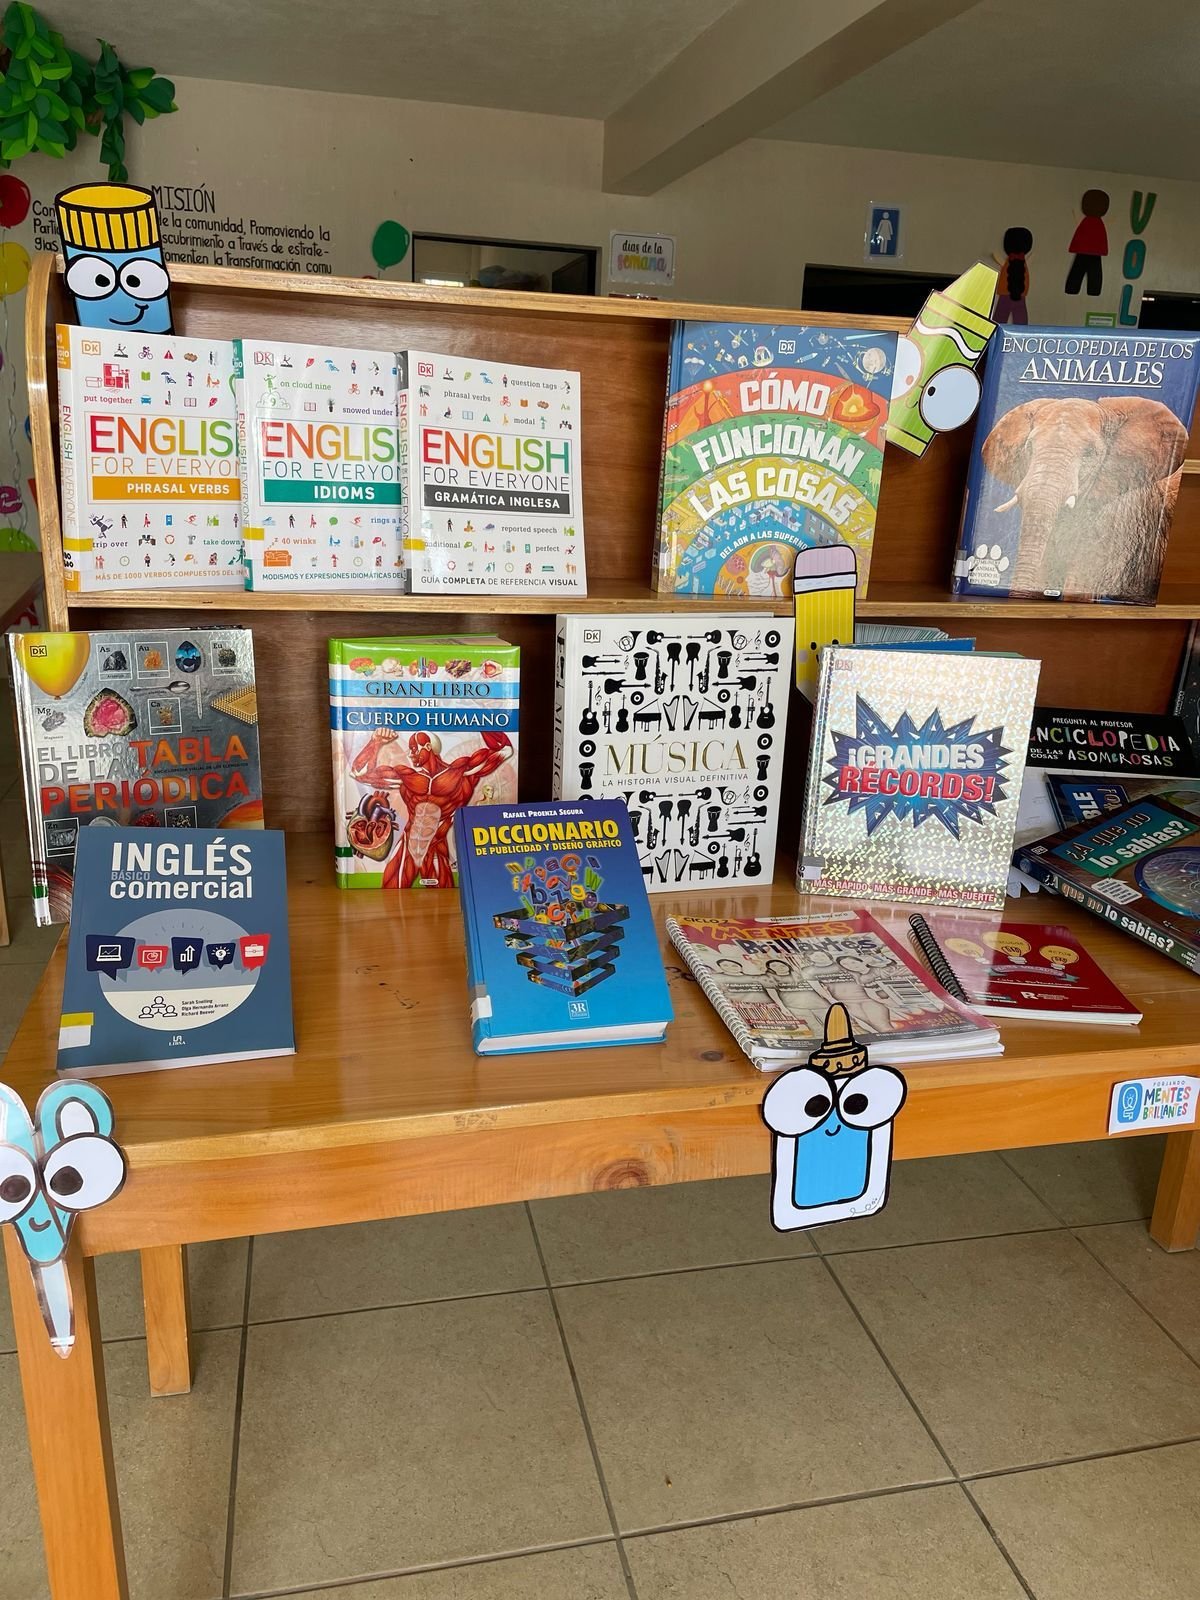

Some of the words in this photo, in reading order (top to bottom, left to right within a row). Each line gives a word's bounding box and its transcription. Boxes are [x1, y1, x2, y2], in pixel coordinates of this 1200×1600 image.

[151, 183, 215, 214] MISIÓN
[172, 212, 182, 228] la
[185, 217, 247, 236] comunidad,
[250, 220, 315, 239] Promoviendo
[319, 225, 331, 241] la
[162, 231, 224, 250] scubrimiento
[228, 239, 236, 249] a
[271, 239, 284, 254] de
[642, 240, 652, 254] de
[654, 242, 663, 255] la
[213, 251, 223, 266] la
[84, 342, 99, 354] DK
[780, 342, 794, 353] DK
[1001, 336, 1130, 358] ENCICLOPEDIA
[1132, 341, 1157, 359] DE
[1160, 342, 1195, 360] LOS
[255, 352, 273, 363] DK
[419, 363, 432, 375] DK
[1020, 357, 1165, 385] ANIMALES
[292, 380, 312, 389] cloud
[314, 382, 332, 391] nine
[510, 377, 540, 390] question
[541, 380, 558, 391] tags
[84, 394, 98, 404] put
[99, 395, 133, 405] together
[443, 389, 471, 401] phrasal
[472, 392, 491, 403] verbs
[738, 372, 831, 416] CÓMO
[342, 405, 370, 416] snowed
[371, 407, 394, 417] under
[513, 416, 536, 426] modal
[62, 405, 73, 460] ENGLISH
[90, 414, 239, 457] ENGLIS
[239, 412, 247, 465] ENGLISH
[261, 422, 400, 463] ENGLIS
[422, 428, 570, 474] ENGLISH
[691, 424, 865, 478] FUNCIONAN
[91, 456, 134, 475] FOR
[262, 460, 302, 479] FOR
[423, 466, 459, 485] FOR
[468, 470, 570, 493] EVERYONE
[126, 483, 186, 495] PHRASAL
[189, 483, 230, 495] VERBS
[313, 485, 375, 500] IDIOMS
[689, 470, 751, 522] LAS
[756, 467, 859, 525] COSAS
[434, 491, 506, 506] GRAMÁTICA
[509, 496, 560, 509] INGLESA
[501, 524, 533, 534] reported
[533, 525, 558, 535] speech
[112, 540, 128, 548] over
[203, 538, 222, 546] take
[223, 538, 241, 546] down
[293, 537, 316, 545] winks
[535, 543, 560, 553] perfect
[719, 545, 734, 560] DEL
[732, 535, 749, 549] ADN
[750, 532, 756, 541] A
[757, 530, 773, 539] LAS
[144, 571, 173, 579] VERBOS
[174, 570, 221, 578] COMPUESTOS
[222, 569, 234, 577] DEL
[262, 573, 299, 581] MODISMOS
[305, 572, 350, 580] EXPRESIONES
[350, 571, 392, 580] IDIOMÁTICAS
[420, 573, 441, 585] GUÍA
[442, 576, 486, 586] COMPLETA
[488, 576, 499, 586] DE
[500, 577, 547, 587] REFERENCIA
[549, 577, 578, 587] VISUAL
[585, 631, 600, 642] DK
[31, 647, 46, 656] DK
[99, 645, 111, 653] As
[365, 680, 423, 697] GRAN
[431, 681, 491, 697] LIBRO
[419, 698, 439, 707] DEL
[36, 707, 52, 717] Mg
[346, 710, 420, 727] CUERPO
[425, 712, 510, 727] HUMANO
[1052, 717, 1088, 726] PREGUNTA
[1100, 720, 1134, 729] PROFESOR
[37, 746, 57, 763] EL
[67, 742, 124, 761] LIBRO
[128, 735, 249, 769] TABLA
[603, 733, 749, 776] MÚSICA
[848, 743, 986, 771] ¡GRANDES
[1067, 749, 1174, 767] ASOMBROSAS
[38, 761, 80, 785] DE
[89, 758, 128, 781] LA
[602, 779, 614, 787] LA
[617, 777, 661, 786] HISTORIA
[664, 775, 697, 785] VISUAL
[700, 772, 749, 783] DEFINITIVA
[838, 760, 996, 804] RÉCORDS!
[40, 769, 250, 816] PERIÓDICA
[472, 820, 620, 847] DICCIONARIO
[475, 847, 488, 856] DE
[489, 845, 542, 855] PUBLICIDAD
[552, 840, 584, 851] DISEÑO
[585, 838, 622, 849] GRÁFICO
[1088, 854, 1119, 869] lo
[1116, 820, 1191, 858] sabías?
[110, 836, 253, 876] INGLÉS
[111, 870, 151, 881] BÁSICO
[110, 876, 253, 899] comercial
[813, 878, 834, 889] MÁS
[836, 879, 868, 892] RÁPIDO
[874, 883, 894, 894] MÁS
[896, 886, 933, 898] GRANDE
[938, 888, 959, 899] MÁS
[961, 891, 995, 903] FUERTE
[683, 916, 720, 924] CICLO
[1061, 882, 1085, 903] que
[1087, 897, 1104, 914] no
[1104, 904, 1118, 921] lo
[1120, 916, 1175, 953] sabías?
[711, 922, 855, 941] MENTES
[735, 936, 877, 955] Brillantes
[570, 1002, 587, 1013] 3R
[1143, 1086, 1192, 1105] MENTES
[1142, 1102, 1189, 1120] BRILLANTES
